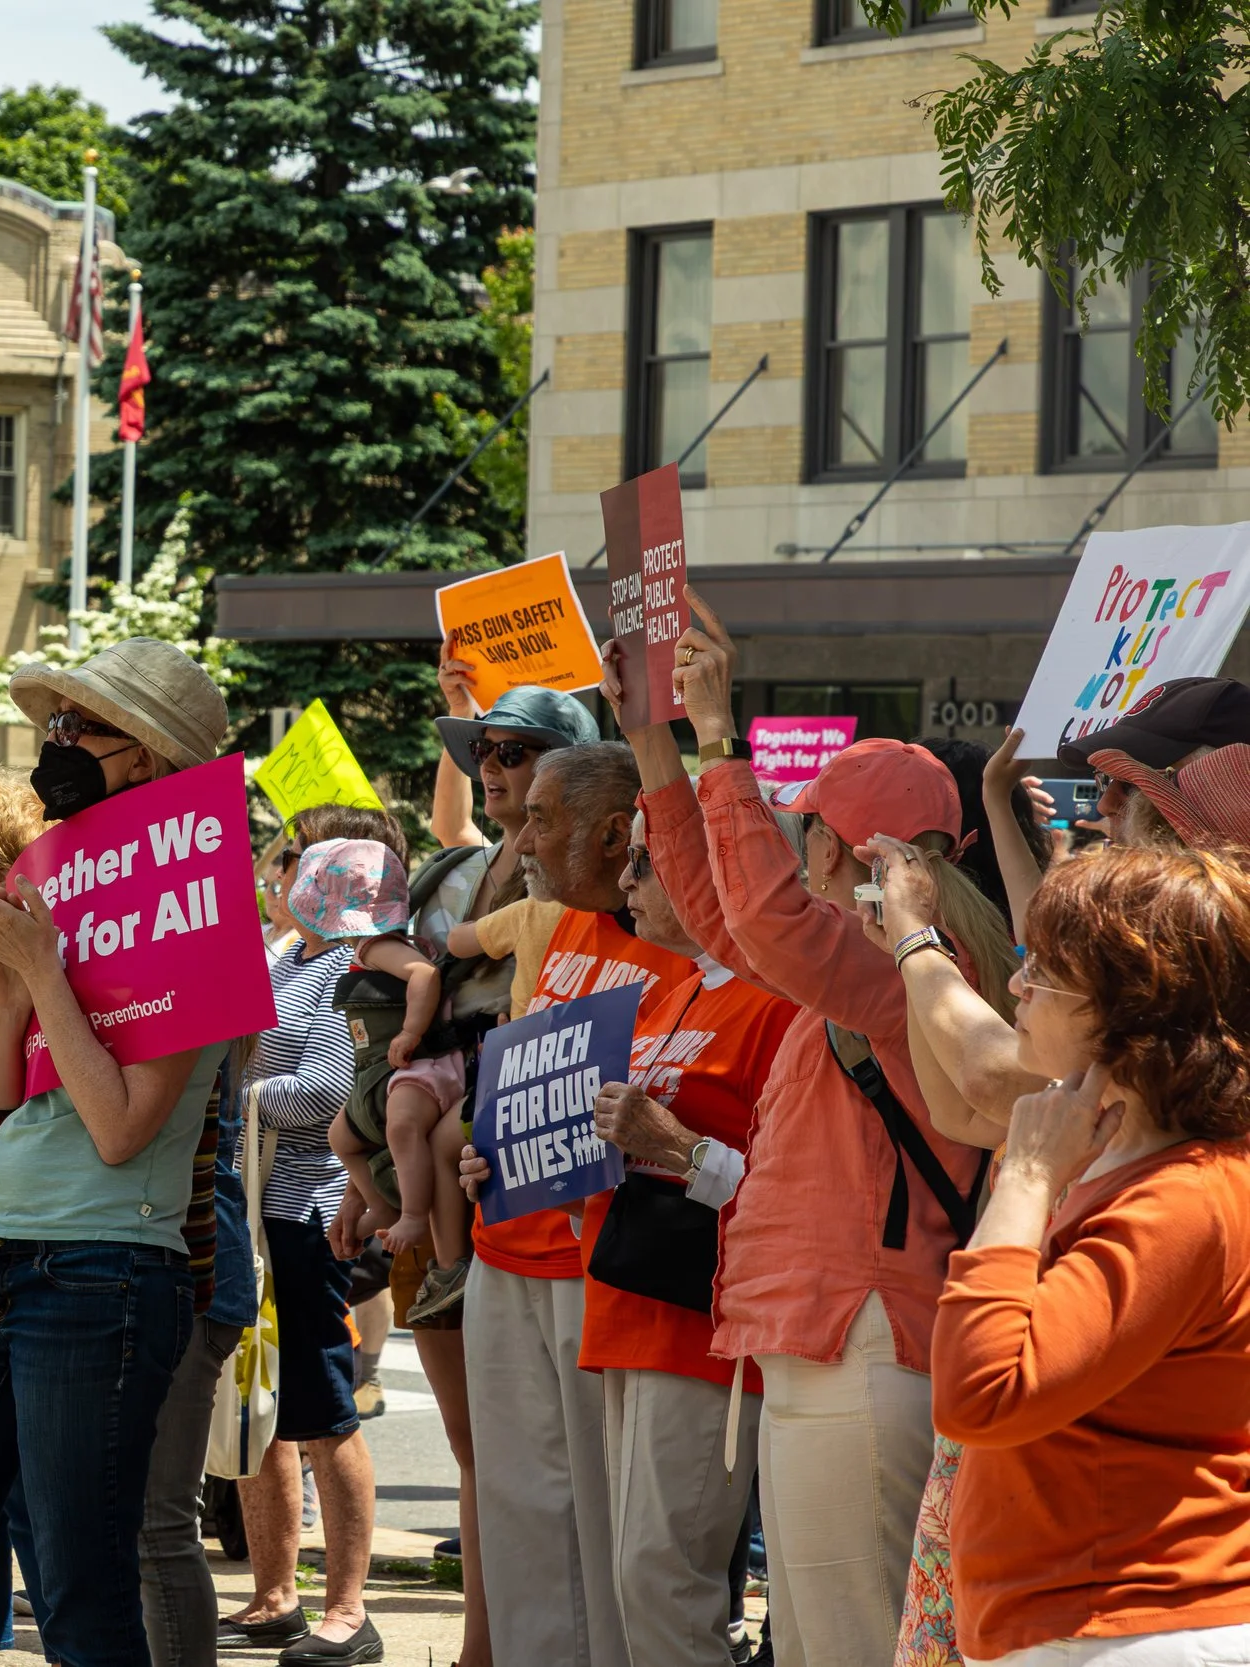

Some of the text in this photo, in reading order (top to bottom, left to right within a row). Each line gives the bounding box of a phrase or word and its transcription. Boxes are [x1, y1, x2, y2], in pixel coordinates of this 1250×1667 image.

[643, 539, 683, 577] PROTECT
[611, 571, 642, 607] STOP GUN
[645, 576, 676, 612] PUBLIC
[452, 597, 566, 649] PASS GUN SAFETY
[614, 603, 645, 638] VIOLENCE
[646, 610, 681, 646] HEALTH
[518, 630, 558, 658] NOW.
[1073, 667, 1148, 712] NOT
[930, 701, 998, 728] FOOD
[755, 727, 847, 750] Together We
[753, 749, 793, 771] Fight
[793, 748, 818, 769] for
[36, 810, 223, 911] ether We
[75, 910, 141, 964] for
[151, 876, 220, 942] All
[497, 1019, 593, 1091] MARCH
[495, 1083, 545, 1140] FOR
[548, 1065, 601, 1124] OUR
[497, 1127, 573, 1191] LIVES
